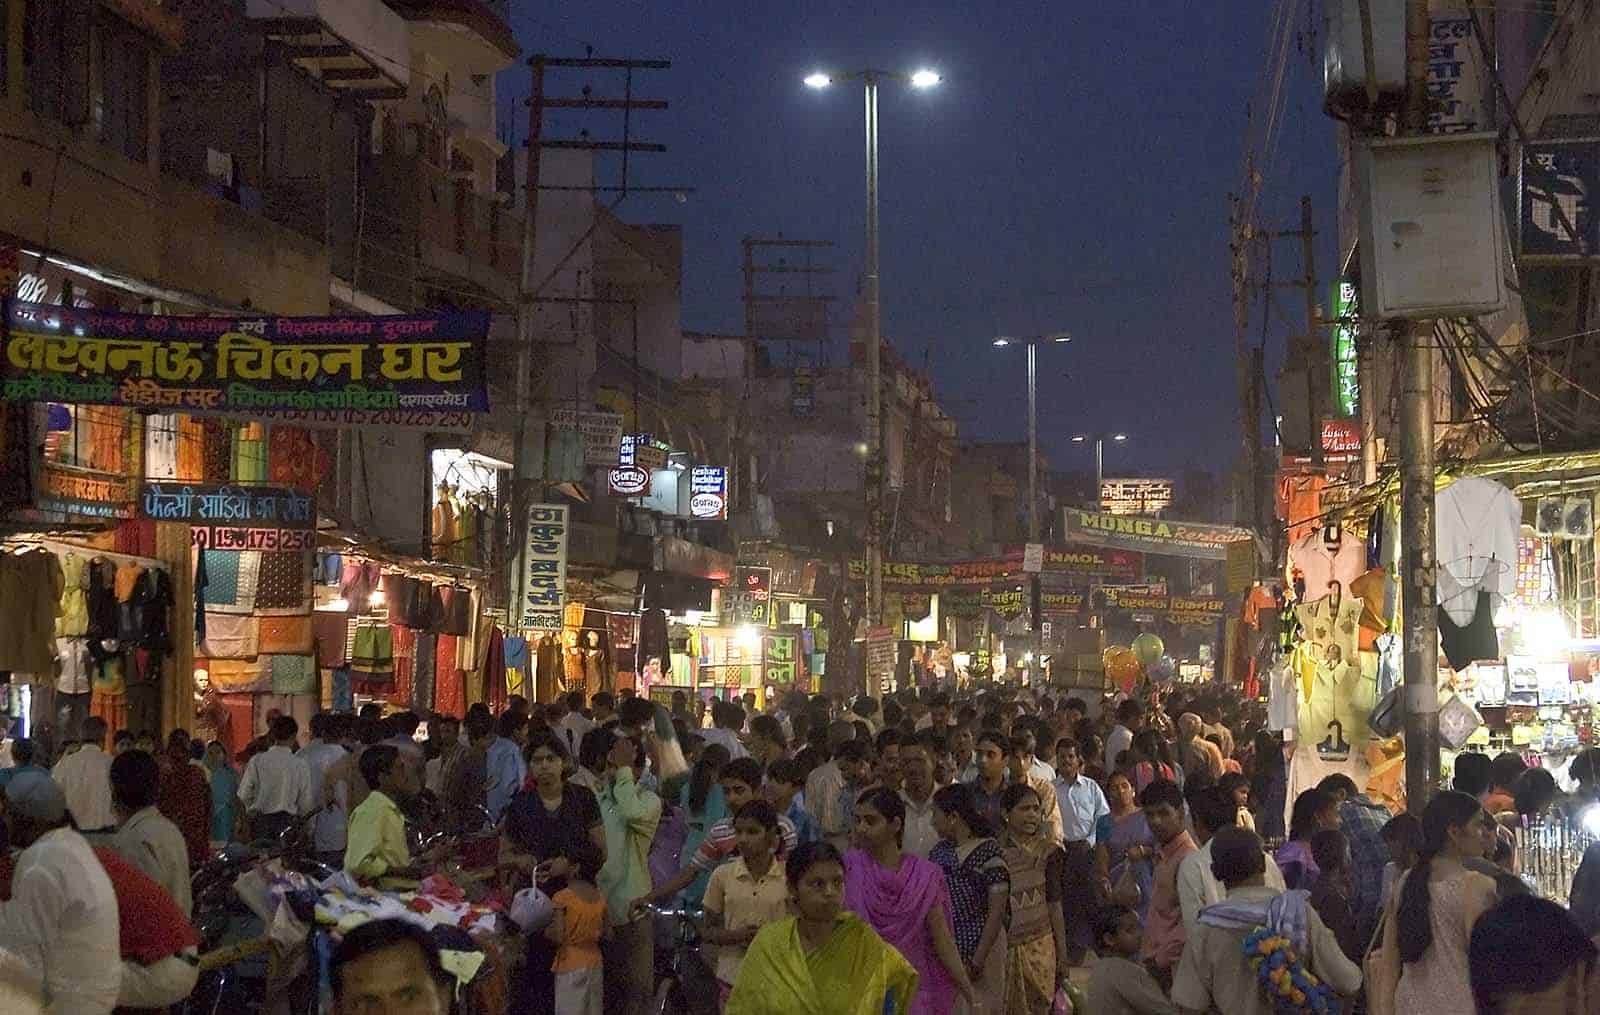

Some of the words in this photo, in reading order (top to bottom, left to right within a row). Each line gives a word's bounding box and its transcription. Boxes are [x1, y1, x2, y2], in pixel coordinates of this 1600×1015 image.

[7, 330, 203, 382] लखनऊ
[216, 332, 369, 382] चिकन
[377, 341, 472, 382] घर
[612, 471, 645, 483] Goras
[692, 498, 720, 509] Goras
[1080, 512, 1172, 538] MONGA
[249, 530, 276, 548] 175
[282, 530, 315, 549] 250
